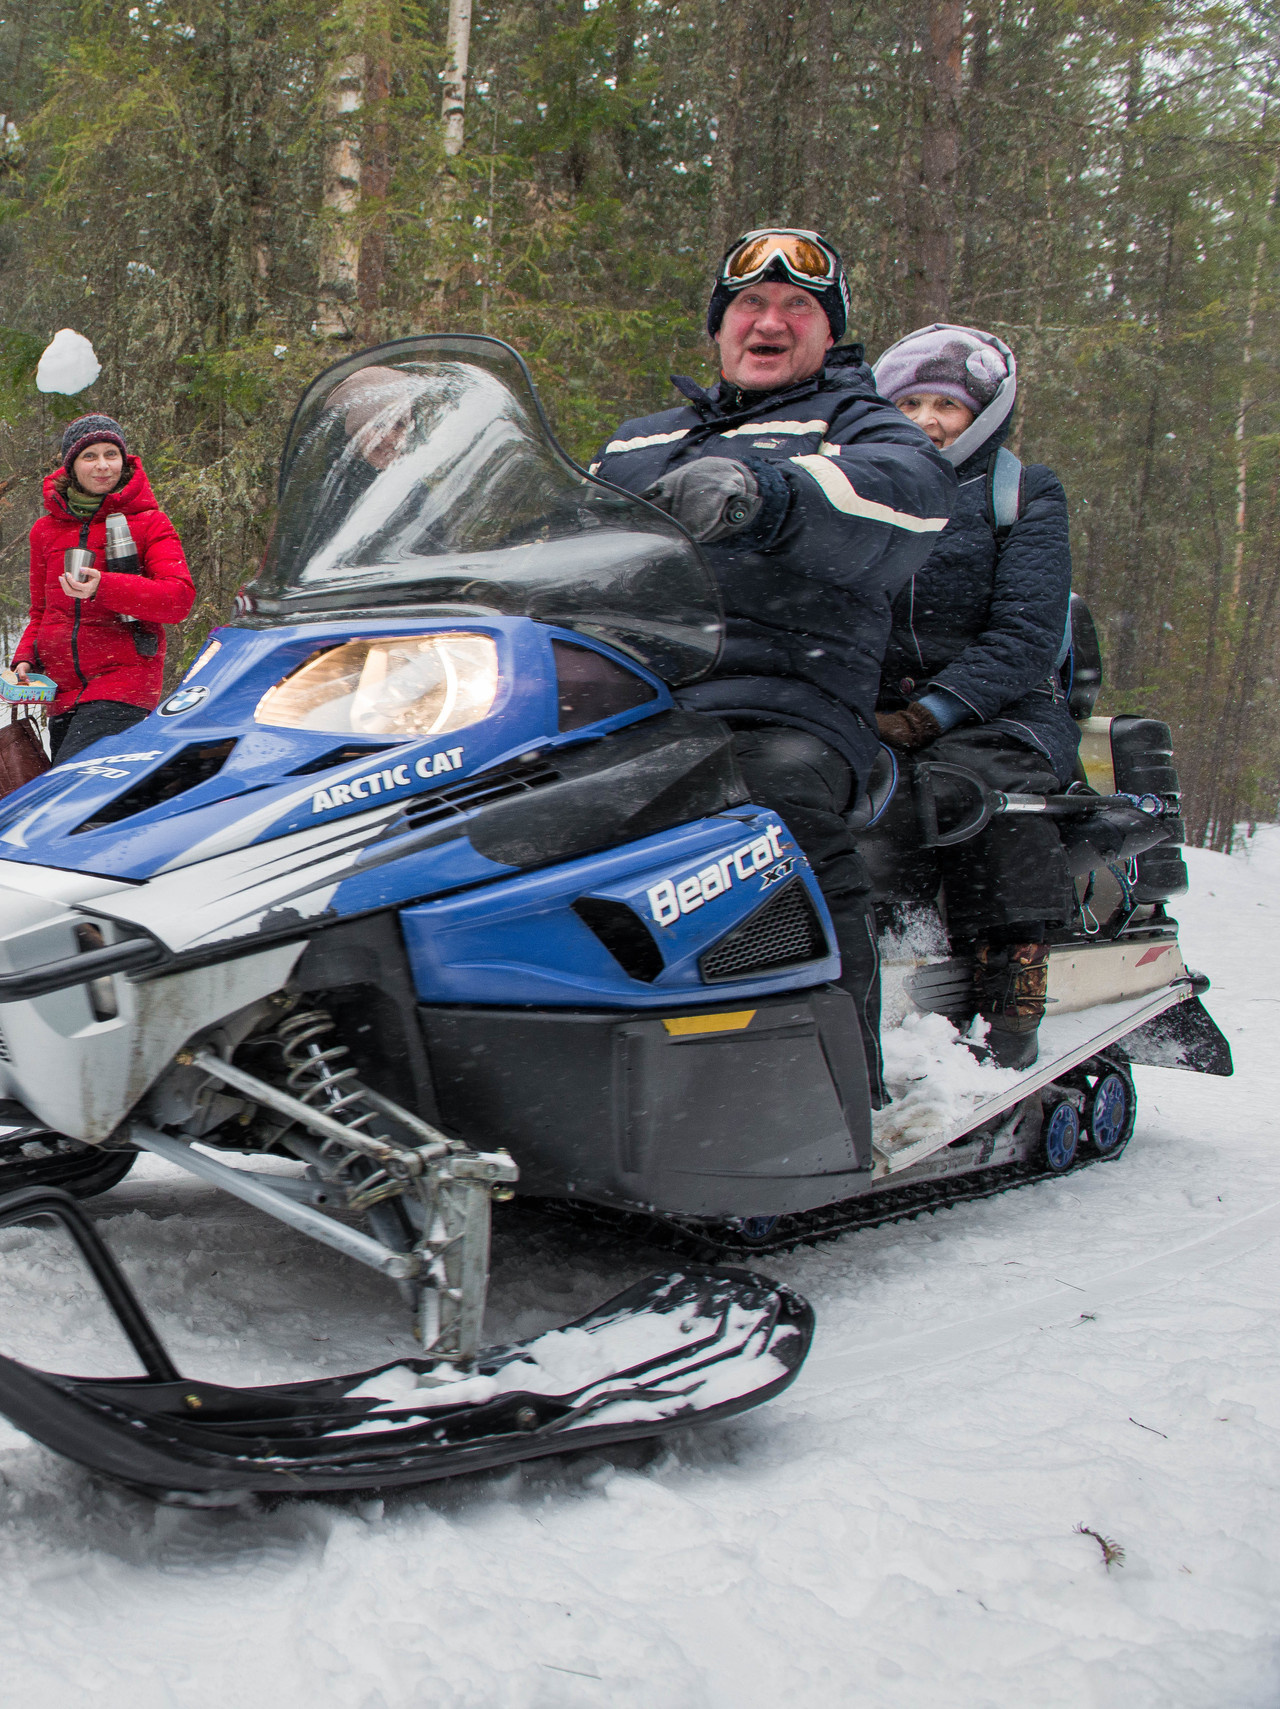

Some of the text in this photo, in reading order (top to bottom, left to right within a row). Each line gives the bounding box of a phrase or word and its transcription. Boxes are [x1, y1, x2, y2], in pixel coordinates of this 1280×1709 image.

[312, 746, 464, 814] ARCTIC CAT
[646, 824, 784, 928] Bearcat
[758, 856, 797, 892] XT
